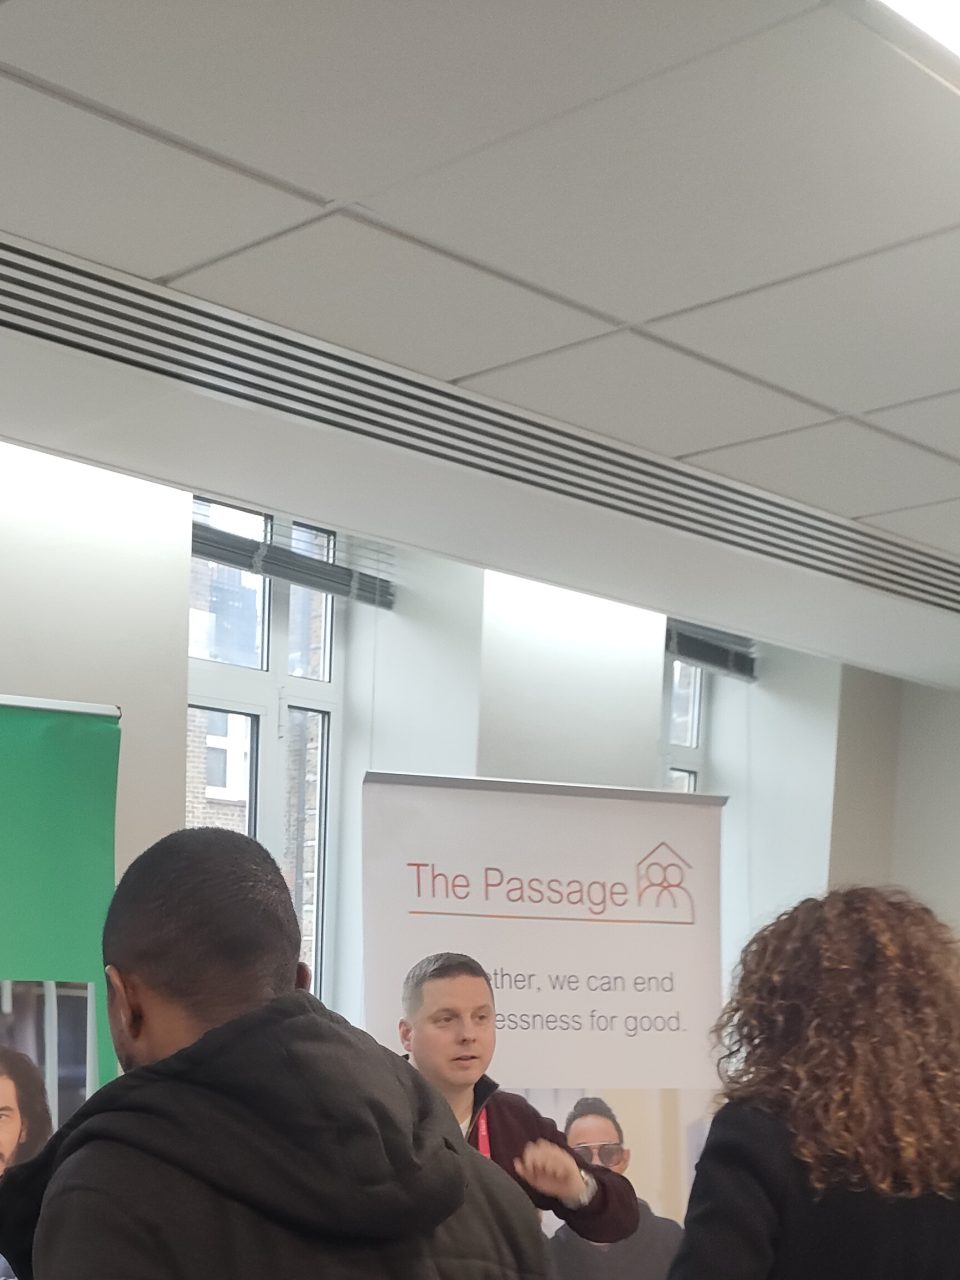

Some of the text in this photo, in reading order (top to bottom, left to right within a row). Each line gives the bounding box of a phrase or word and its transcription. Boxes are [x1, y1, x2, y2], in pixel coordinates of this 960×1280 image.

[406, 863, 629, 915] The Passage
[548, 974, 580, 992] we
[587, 975, 626, 993] can
[633, 972, 674, 993] end
[589, 1010, 619, 1032] for
[624, 1011, 688, 1038] good.
